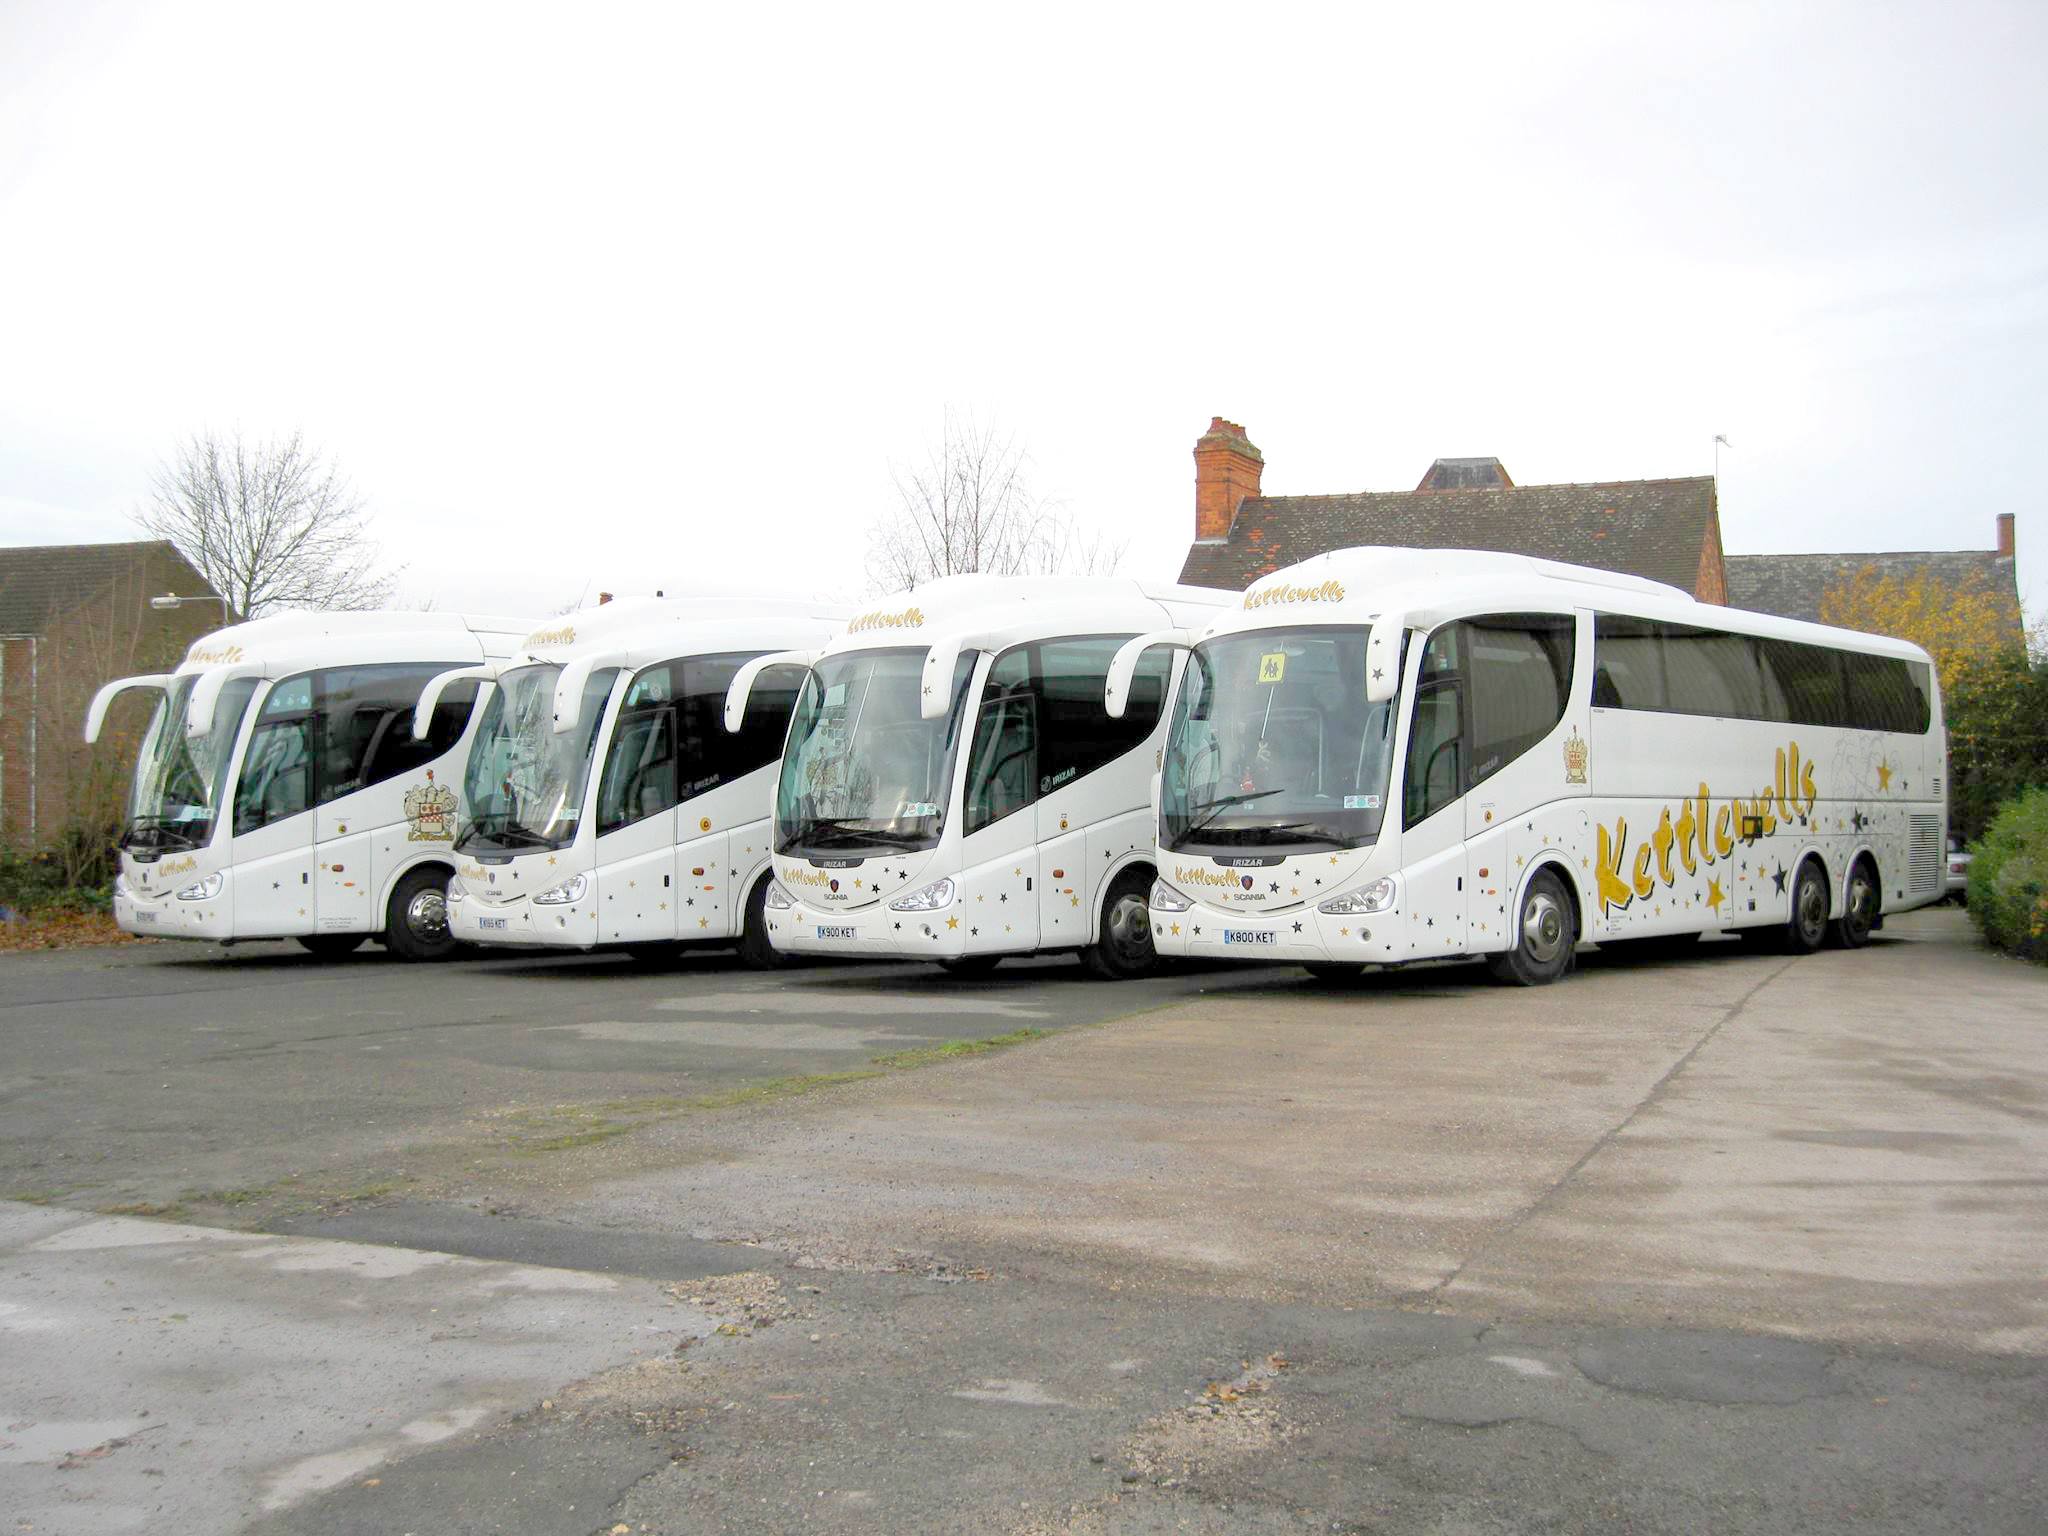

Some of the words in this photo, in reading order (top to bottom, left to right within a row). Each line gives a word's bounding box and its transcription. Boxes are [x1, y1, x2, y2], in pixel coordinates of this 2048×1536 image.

[1243, 579, 1345, 611] Kettlewells
[847, 607, 924, 635] Kettlewells
[1052, 766, 1076, 786] IRIZAR
[1594, 740, 1816, 920] Kettlewells
[1174, 864, 1240, 888] Kettlewells
[823, 893, 848, 901] SCANIA
[1233, 893, 1266, 901] SCANIA
[821, 927, 840, 938] K900
[841, 927, 856, 938] KET
[1230, 931, 1254, 943] K800
[1255, 932, 1275, 943] KET
